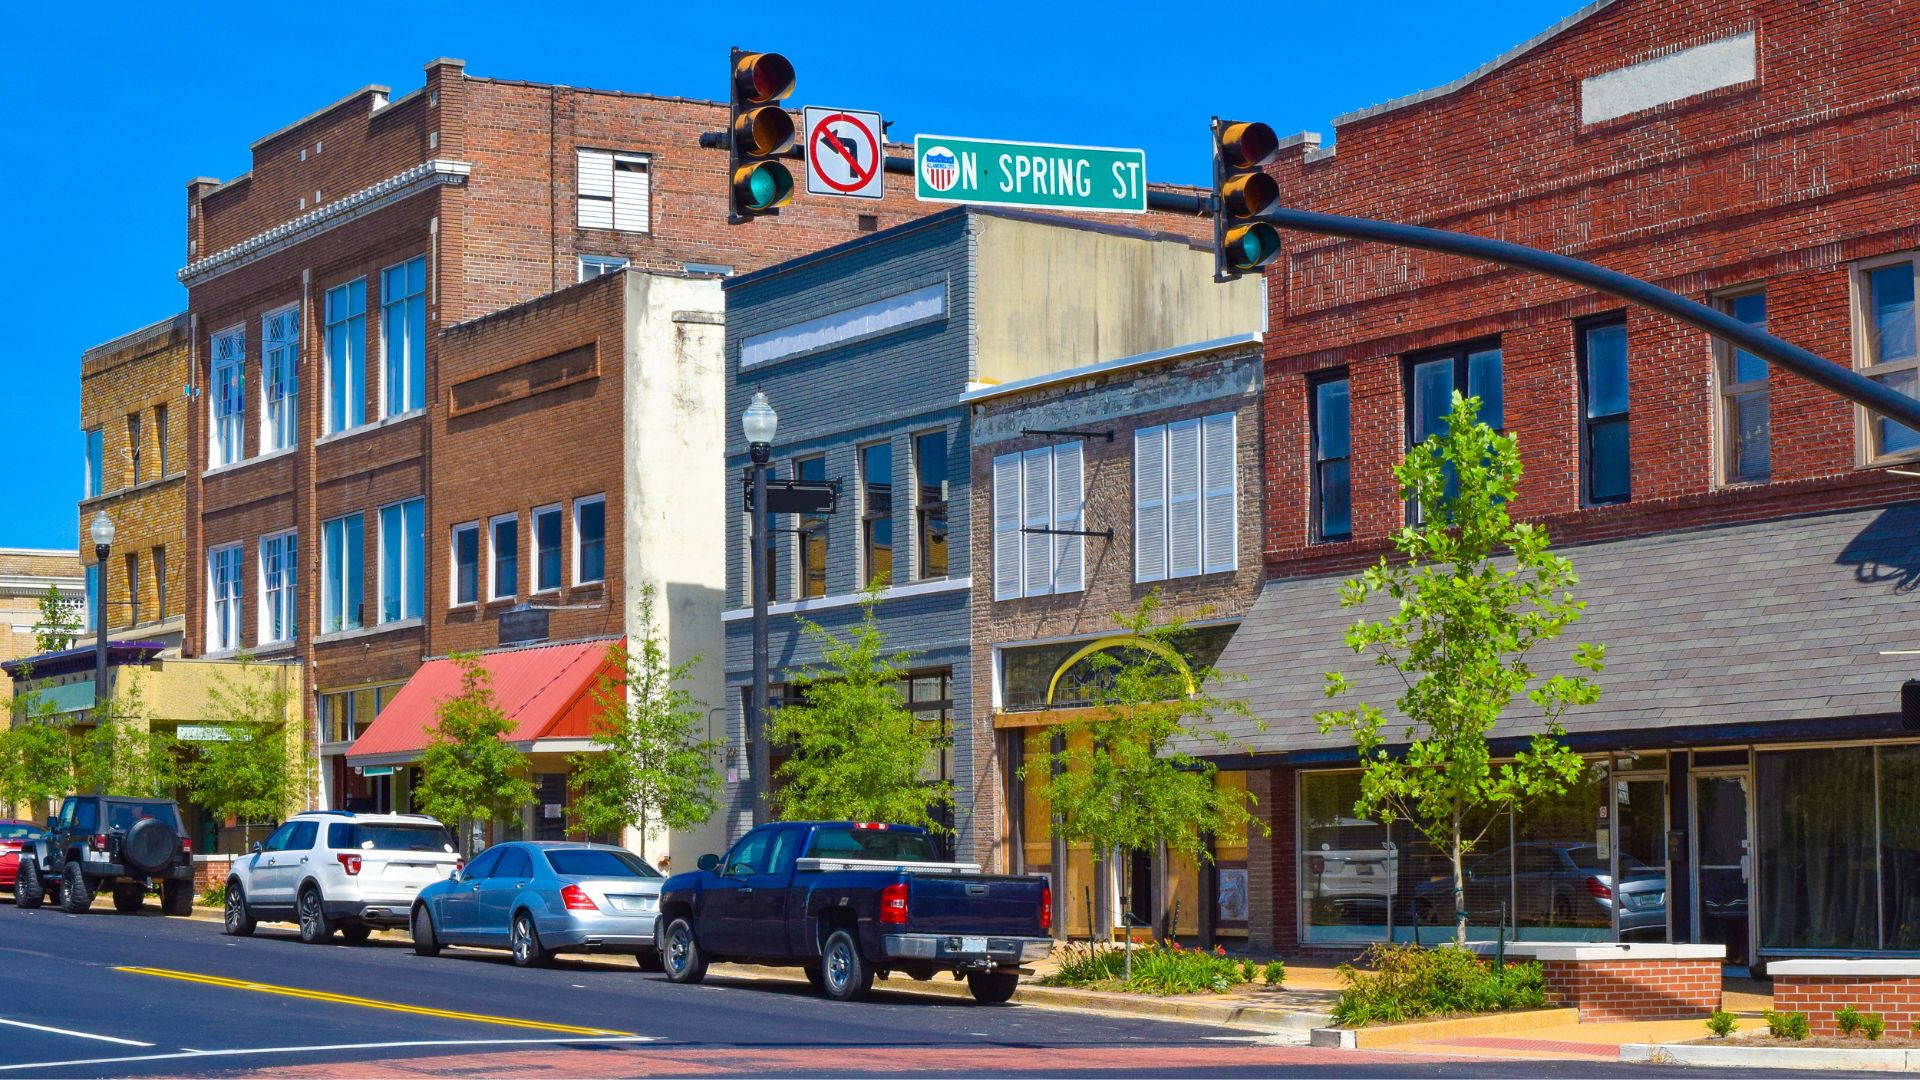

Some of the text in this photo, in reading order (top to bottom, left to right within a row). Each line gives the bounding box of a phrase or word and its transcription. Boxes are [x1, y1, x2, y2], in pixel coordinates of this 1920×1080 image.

[962, 151, 1140, 200] N SPRING ST
